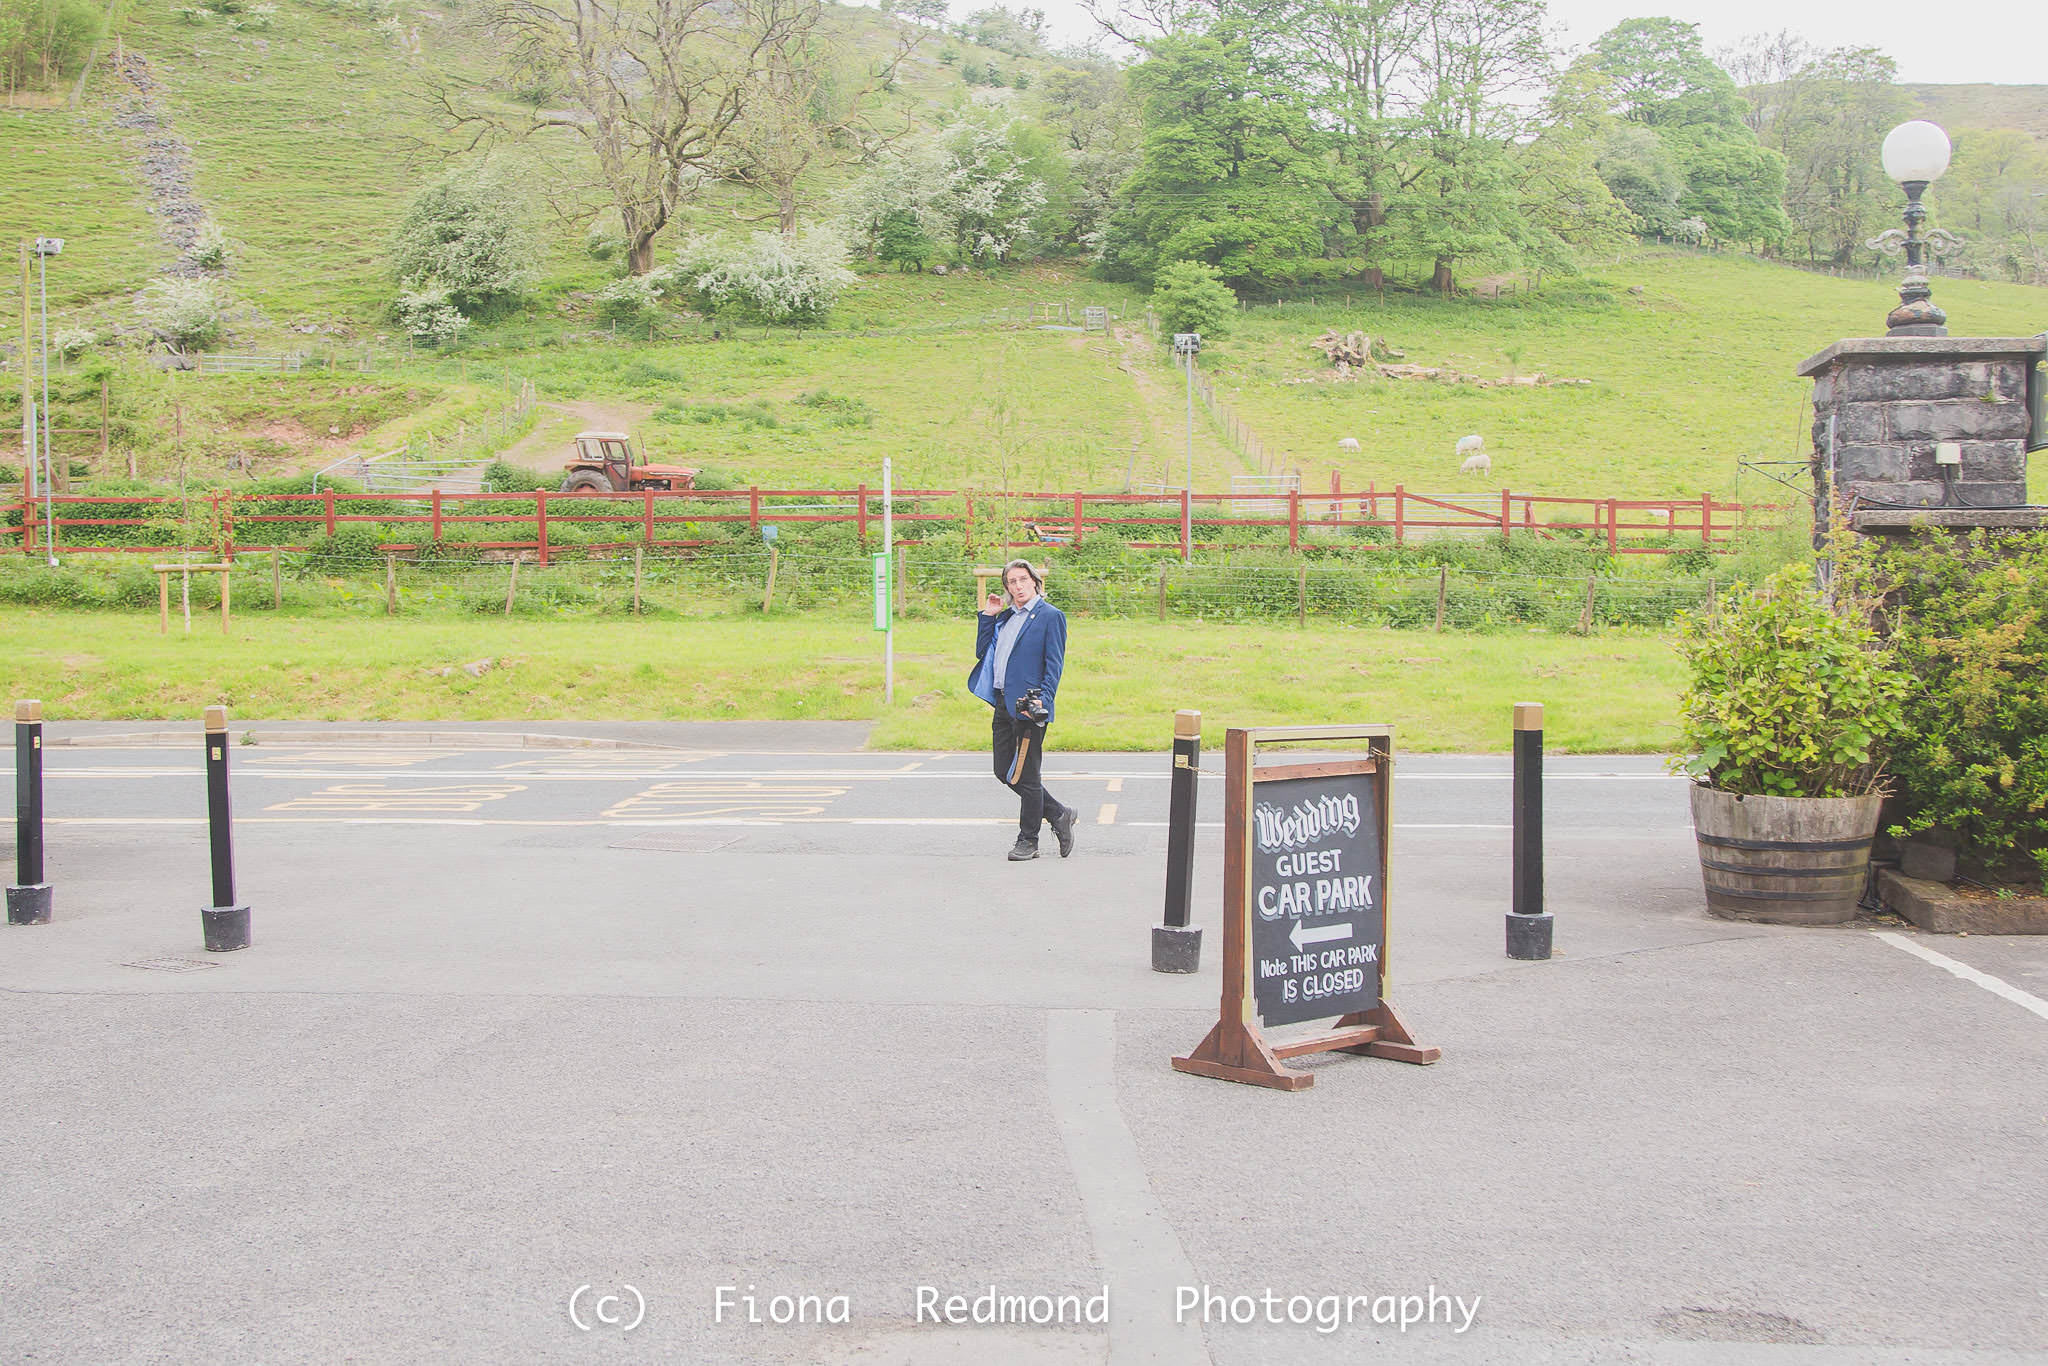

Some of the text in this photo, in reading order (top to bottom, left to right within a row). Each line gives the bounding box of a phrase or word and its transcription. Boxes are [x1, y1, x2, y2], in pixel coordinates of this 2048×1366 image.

[1255, 793, 1361, 851] Wedding
[1276, 849, 1342, 876] GUEST
[1258, 876, 1373, 917] CAR PARK
[1260, 943, 1378, 979] Note THIS CAR PARK
[1283, 968, 1364, 1001] IS CLOSED
